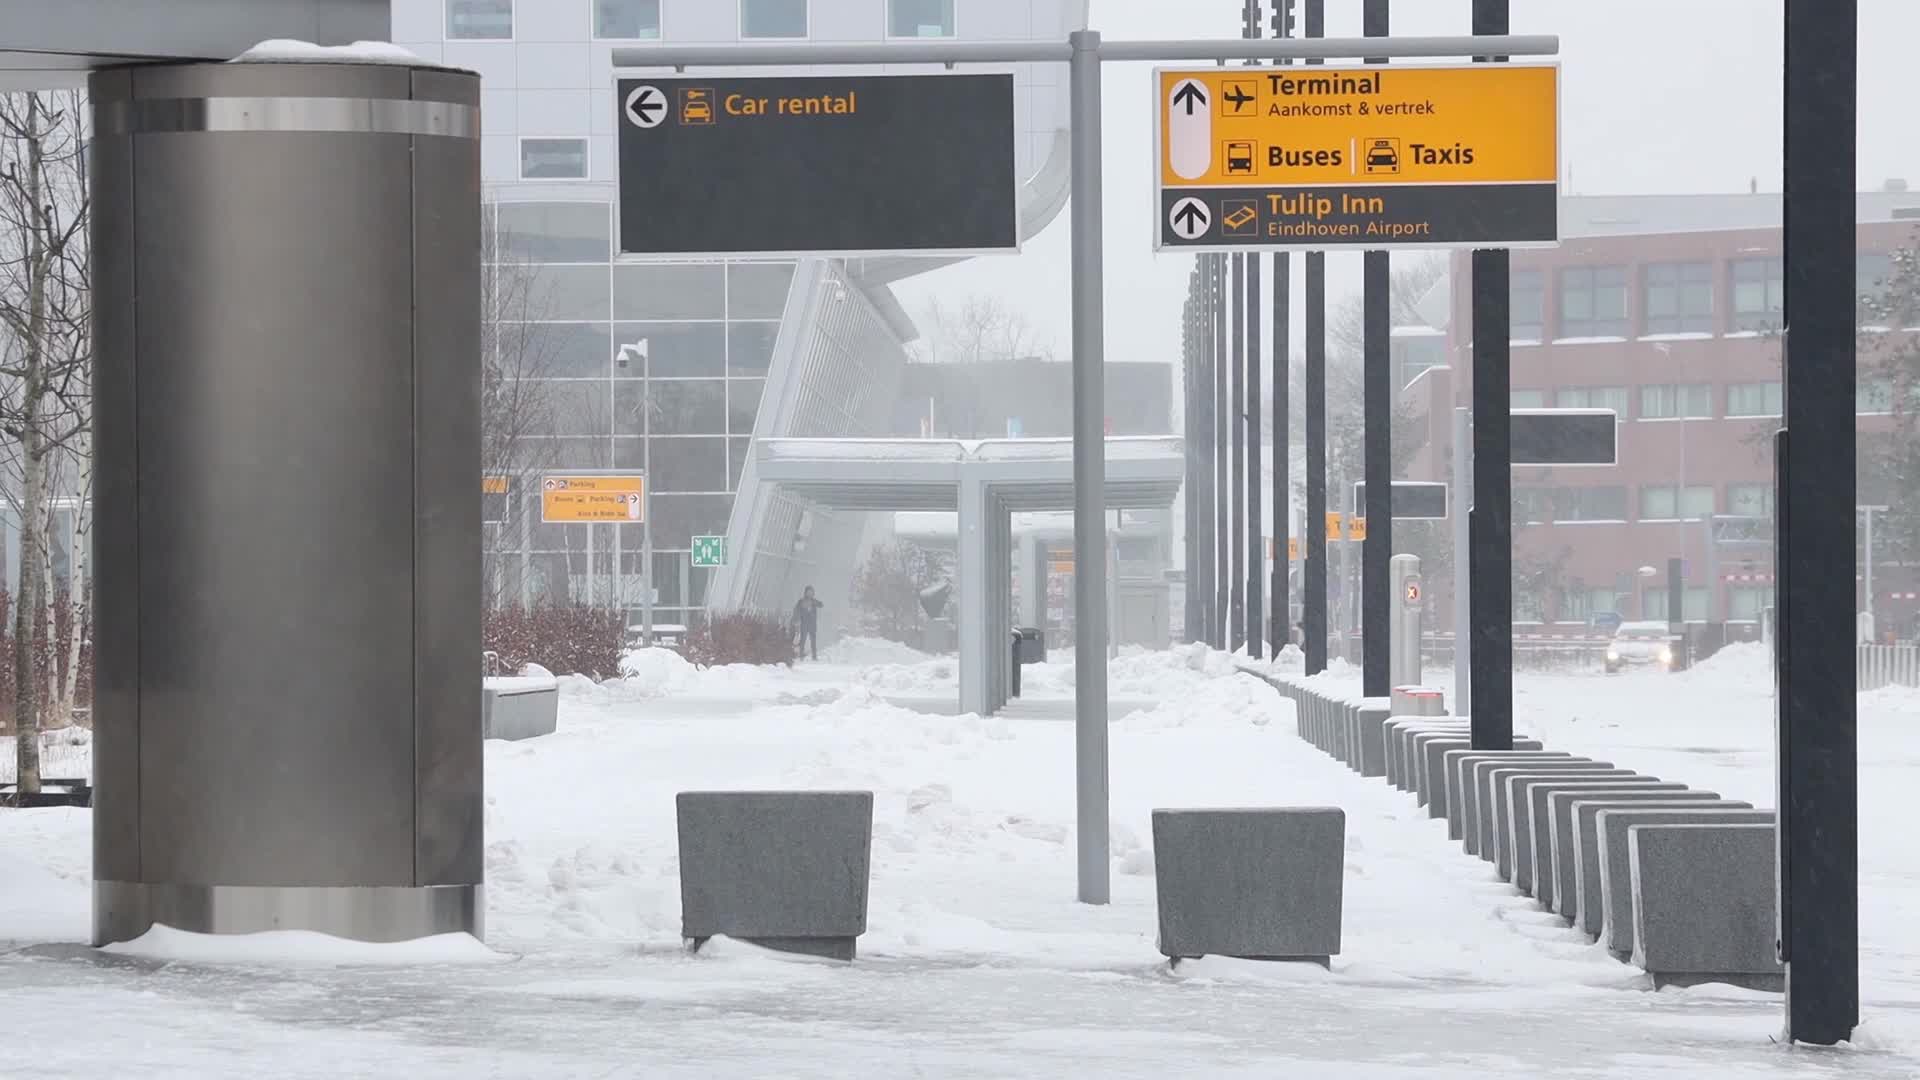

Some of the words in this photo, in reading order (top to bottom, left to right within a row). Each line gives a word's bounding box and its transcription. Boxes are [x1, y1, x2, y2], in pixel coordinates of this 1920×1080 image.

[1268, 72, 1381, 96] Terminal
[724, 93, 769, 115] Car
[778, 91, 857, 115] rental
[1268, 101, 1353, 117] Aankomst
[1358, 101, 1370, 116] &
[1375, 100, 1436, 115] vertrek
[1268, 146, 1343, 167] Buses
[1410, 143, 1475, 165] Taxis
[1267, 193, 1332, 219] Tulip
[1342, 194, 1384, 214] Inn
[1268, 221, 1360, 237] Eindhoven
[1366, 220, 1431, 238] Airport
[569, 480, 596, 489] Parking
